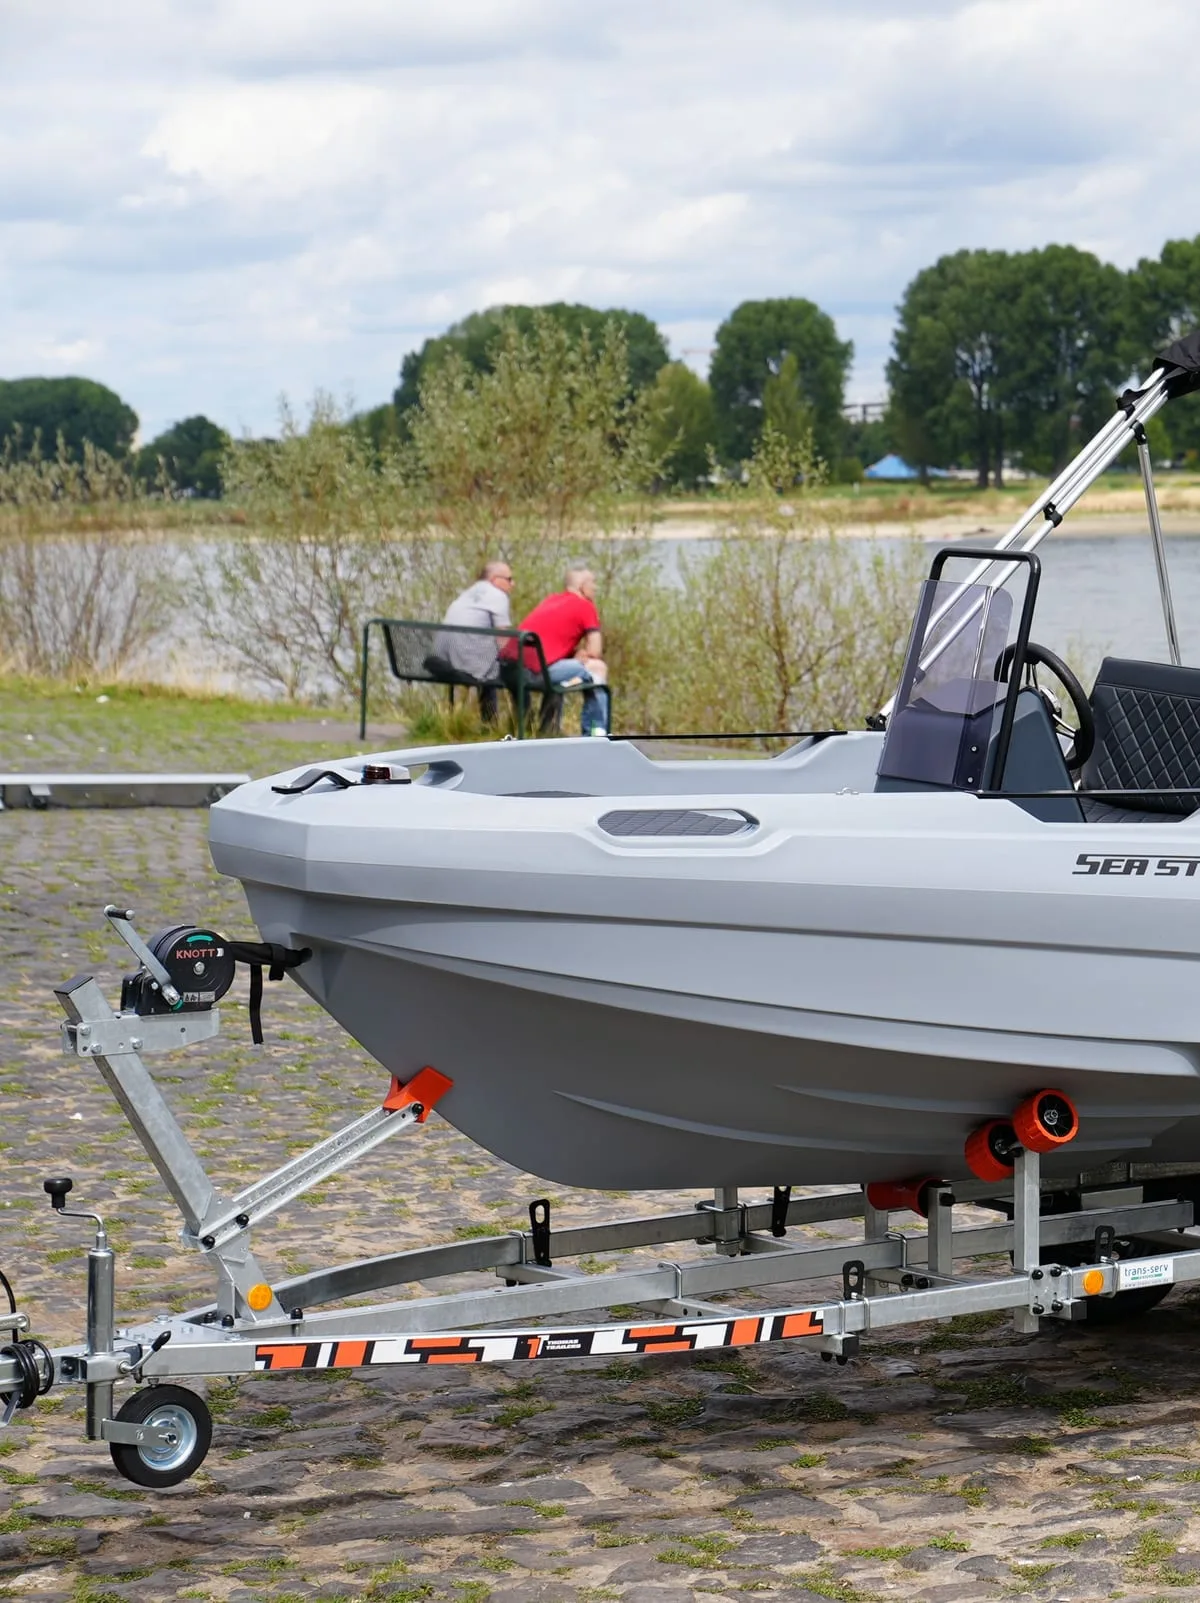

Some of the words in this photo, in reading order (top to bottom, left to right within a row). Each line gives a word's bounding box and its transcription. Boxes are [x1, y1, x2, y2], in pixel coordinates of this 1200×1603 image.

[1072, 853, 1149, 876] SEA
[176, 949, 215, 959] KNOTT
[1125, 1264, 1169, 1277] trans-serv
